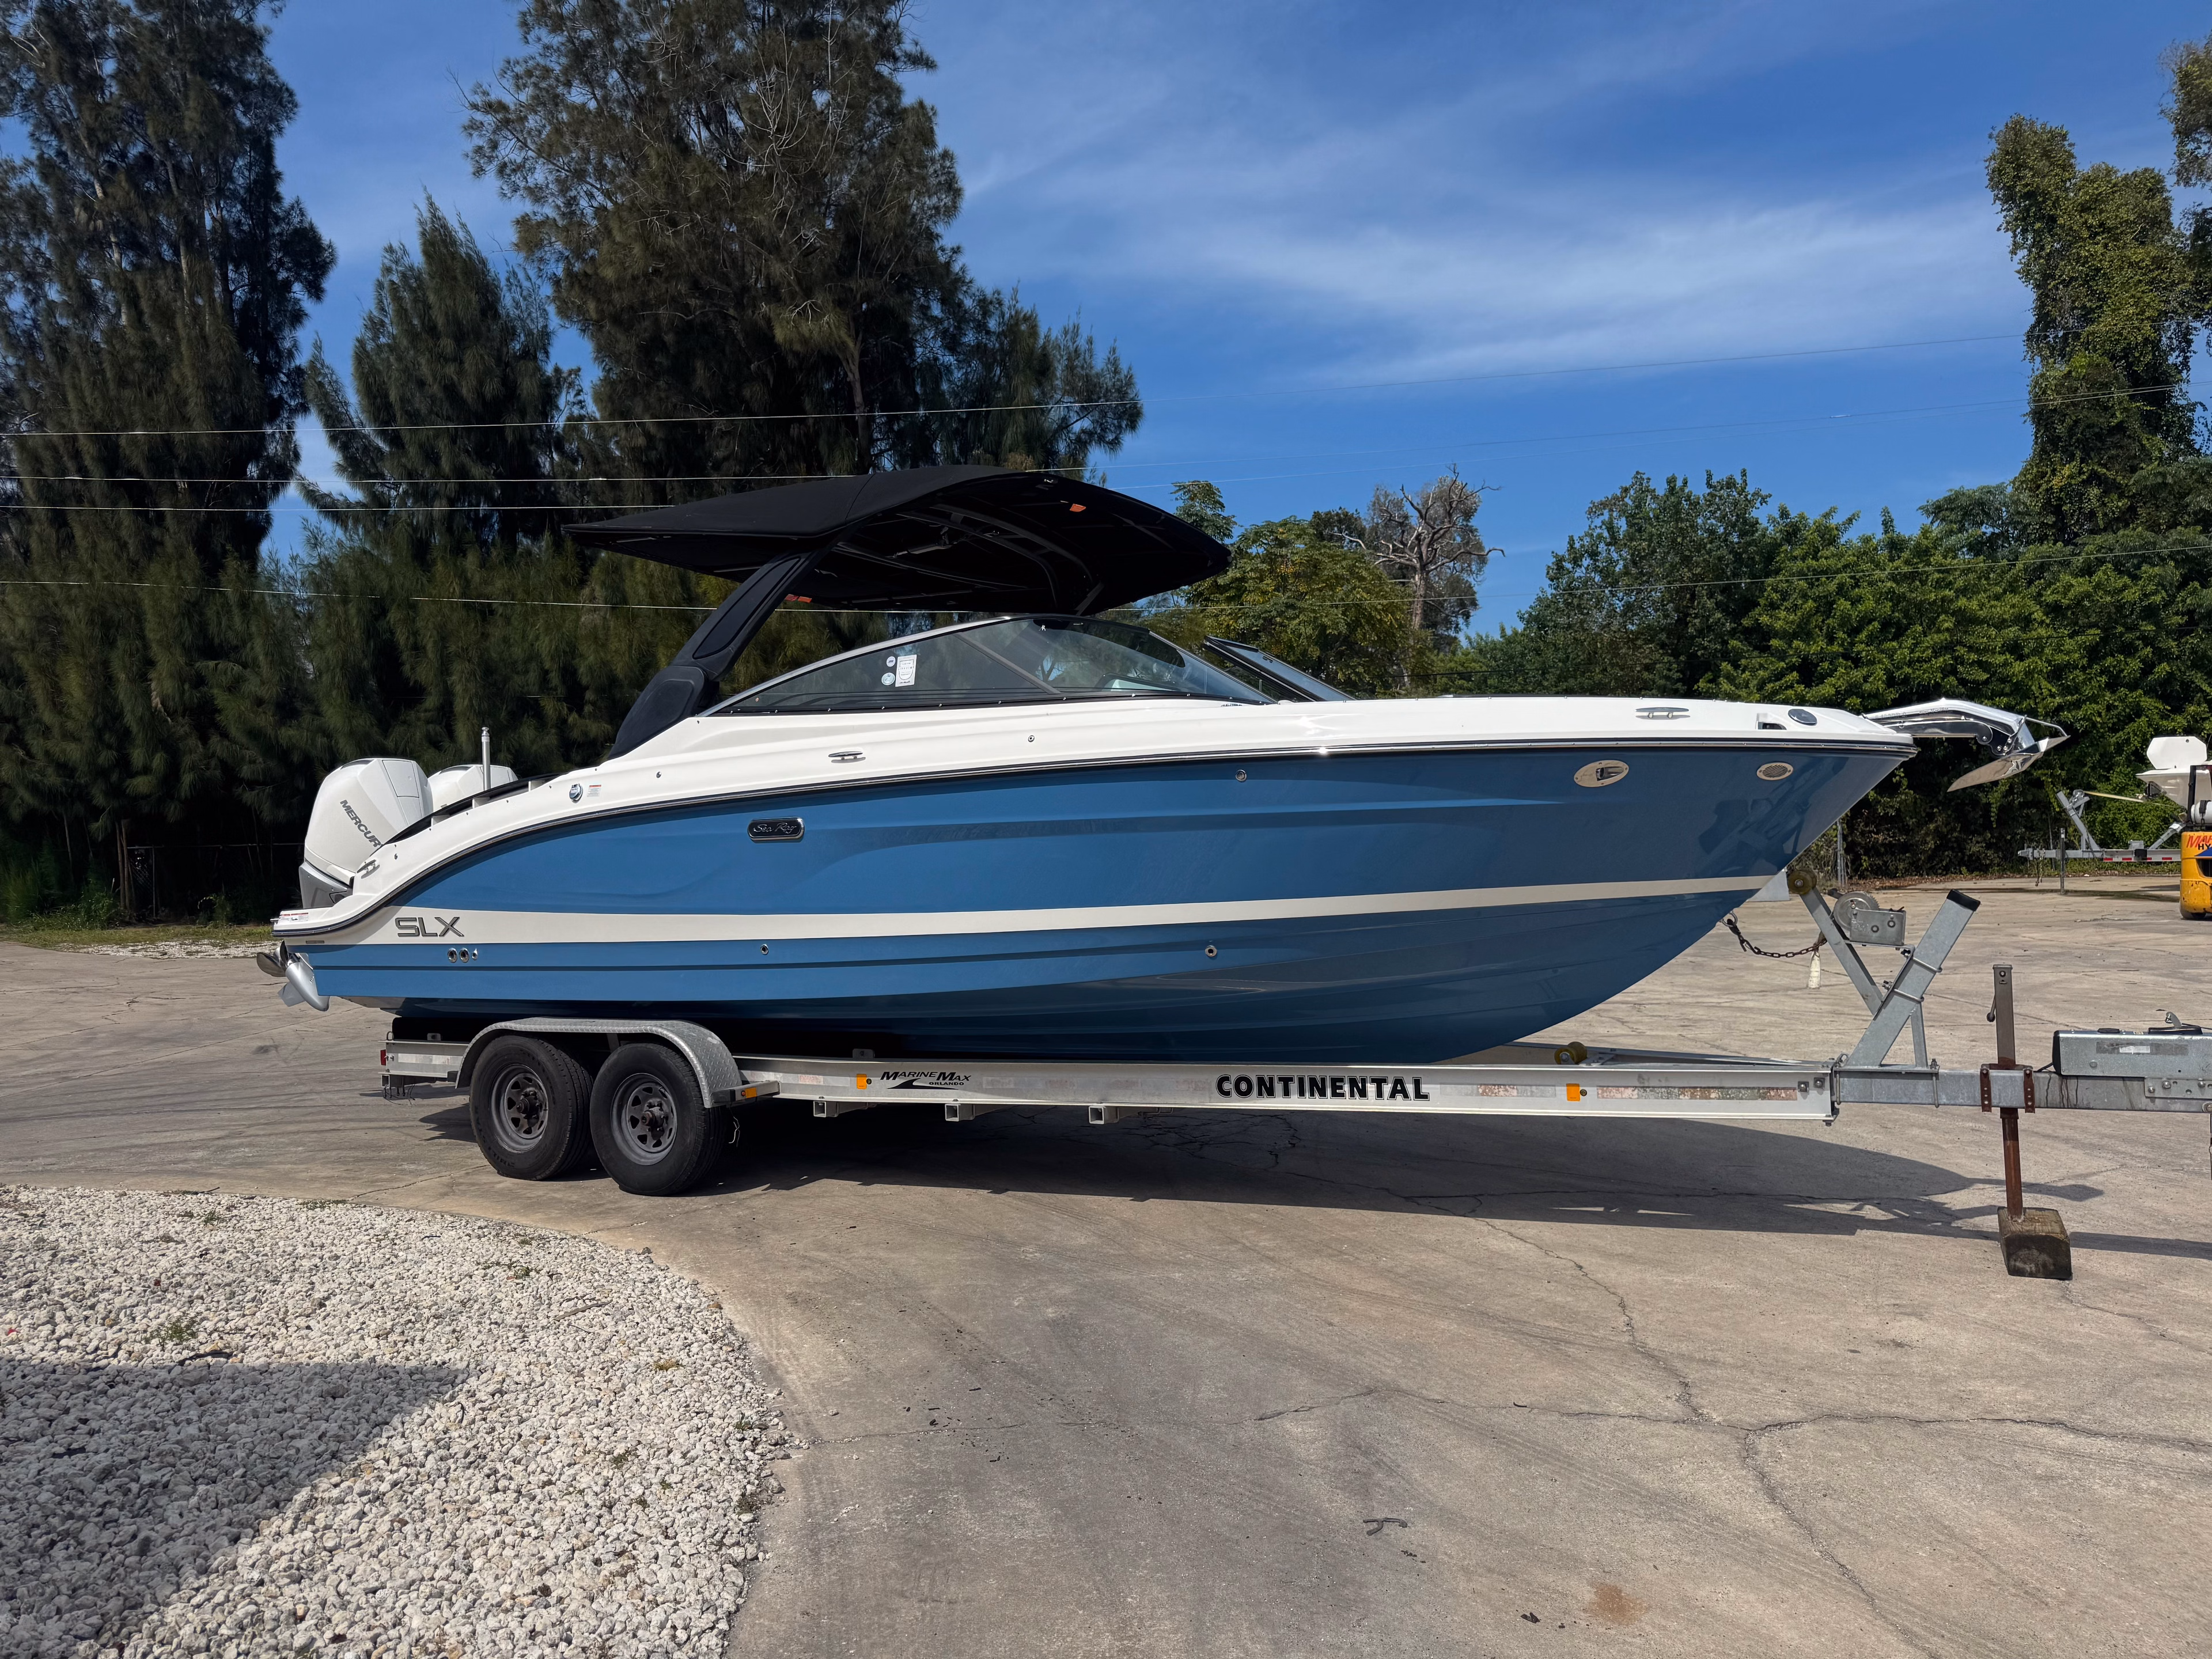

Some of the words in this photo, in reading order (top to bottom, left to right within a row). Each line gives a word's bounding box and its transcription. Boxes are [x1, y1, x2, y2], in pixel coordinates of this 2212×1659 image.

[340, 800, 382, 847] MERCUR
[753, 824, 774, 832] Sea
[774, 822, 797, 834] Ray
[395, 916, 465, 937] SLX
[1215, 1074, 1430, 1101] CONTINENTAL
